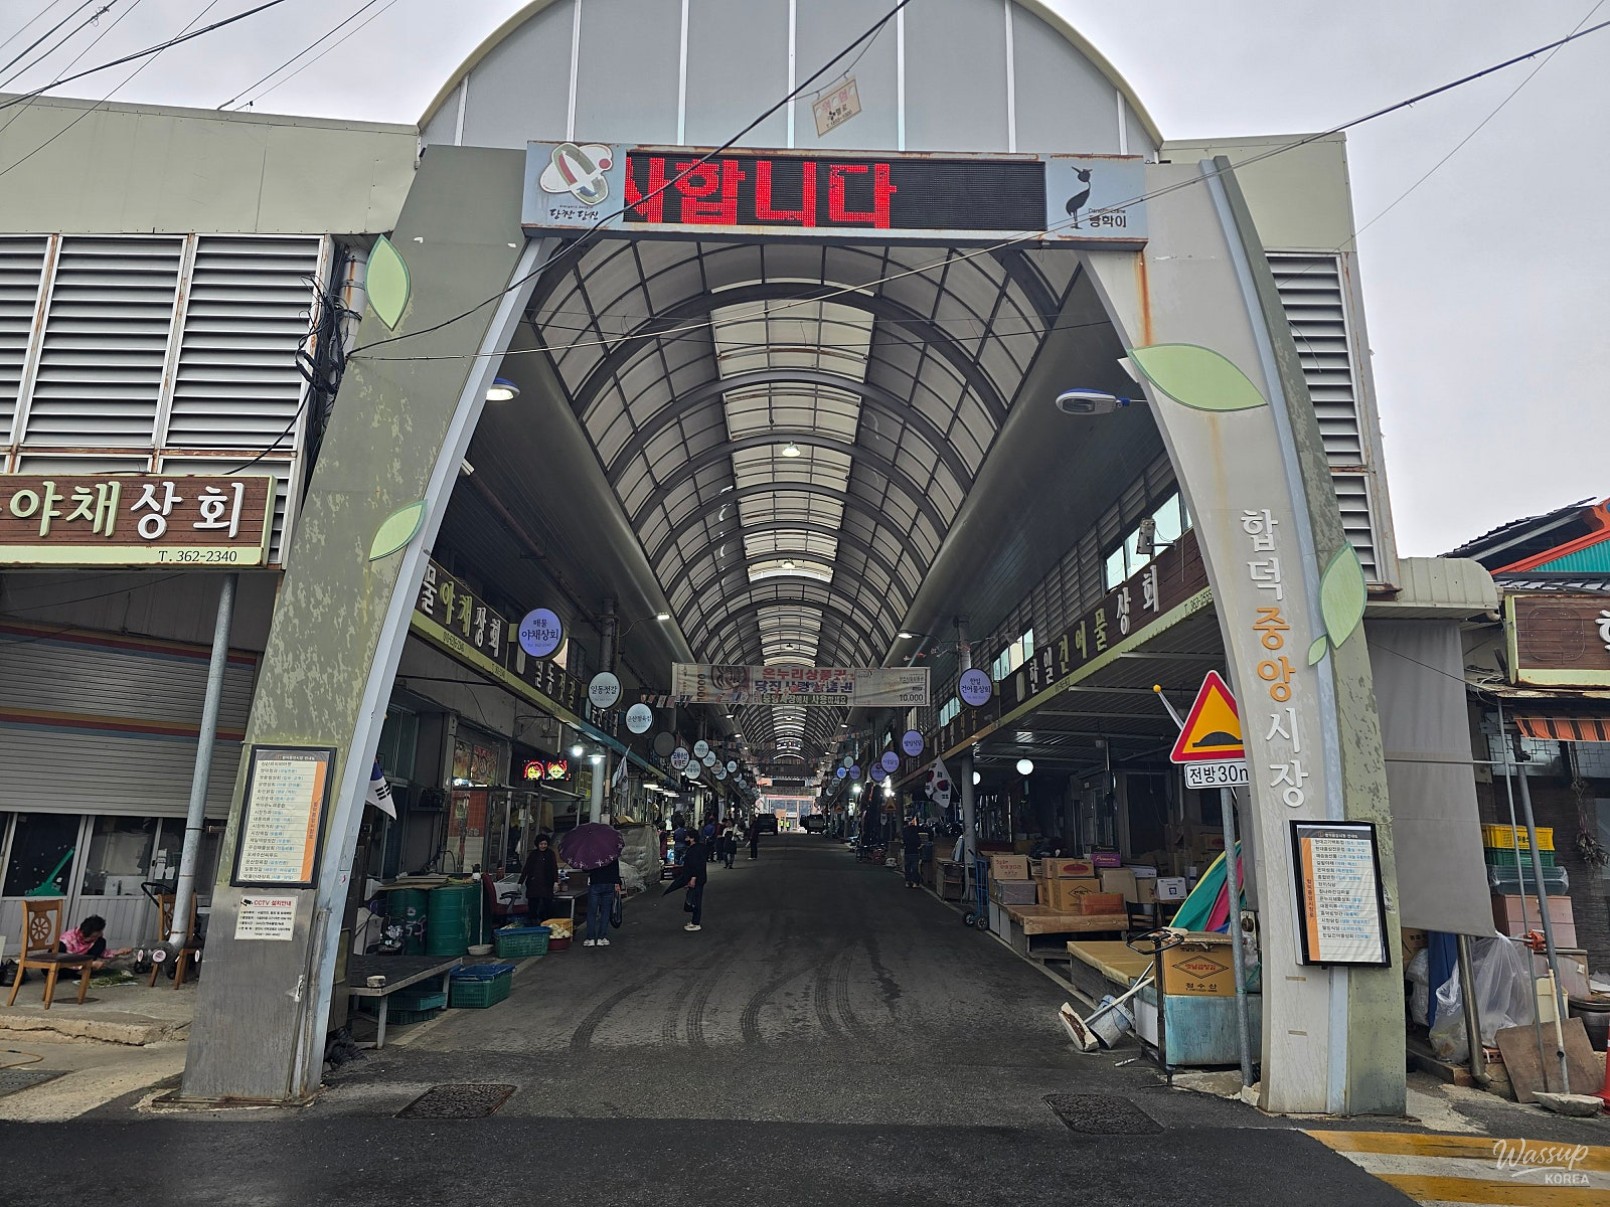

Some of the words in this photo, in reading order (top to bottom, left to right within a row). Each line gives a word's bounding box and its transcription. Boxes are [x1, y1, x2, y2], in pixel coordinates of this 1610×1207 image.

[577, 210, 599, 221] 당진
[0, 481, 244, 540] 야채상회
[521, 629, 559, 641] 야채상회
[899, 693, 923, 702] 10,000
